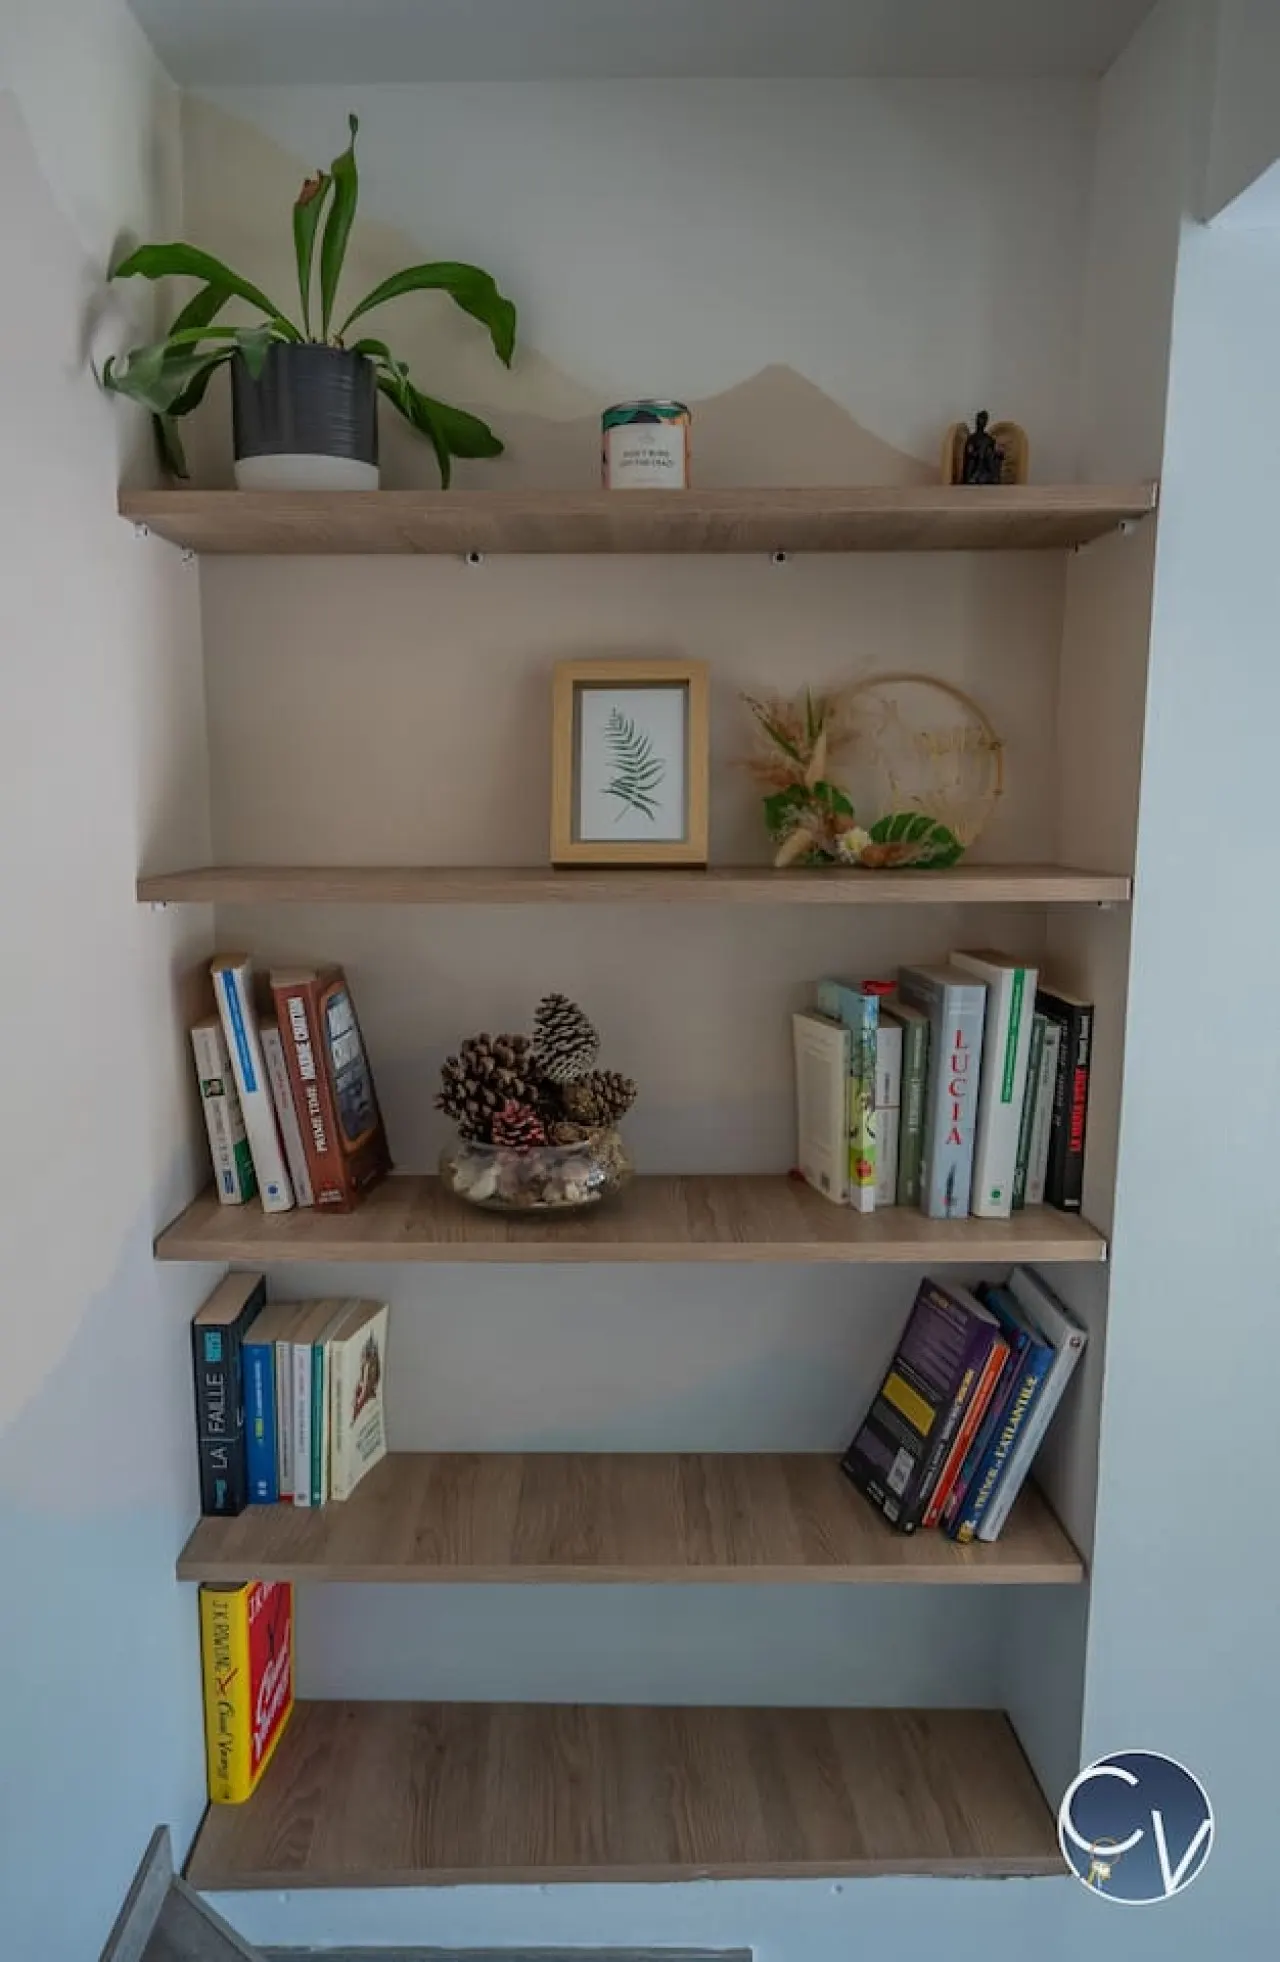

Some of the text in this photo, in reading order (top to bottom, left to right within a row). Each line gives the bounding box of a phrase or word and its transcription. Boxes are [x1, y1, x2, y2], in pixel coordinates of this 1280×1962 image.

[945, 1029, 970, 1145] LUCIA
[206, 1373, 226, 1433] FAILLE
[212, 1445, 228, 1470] LA
